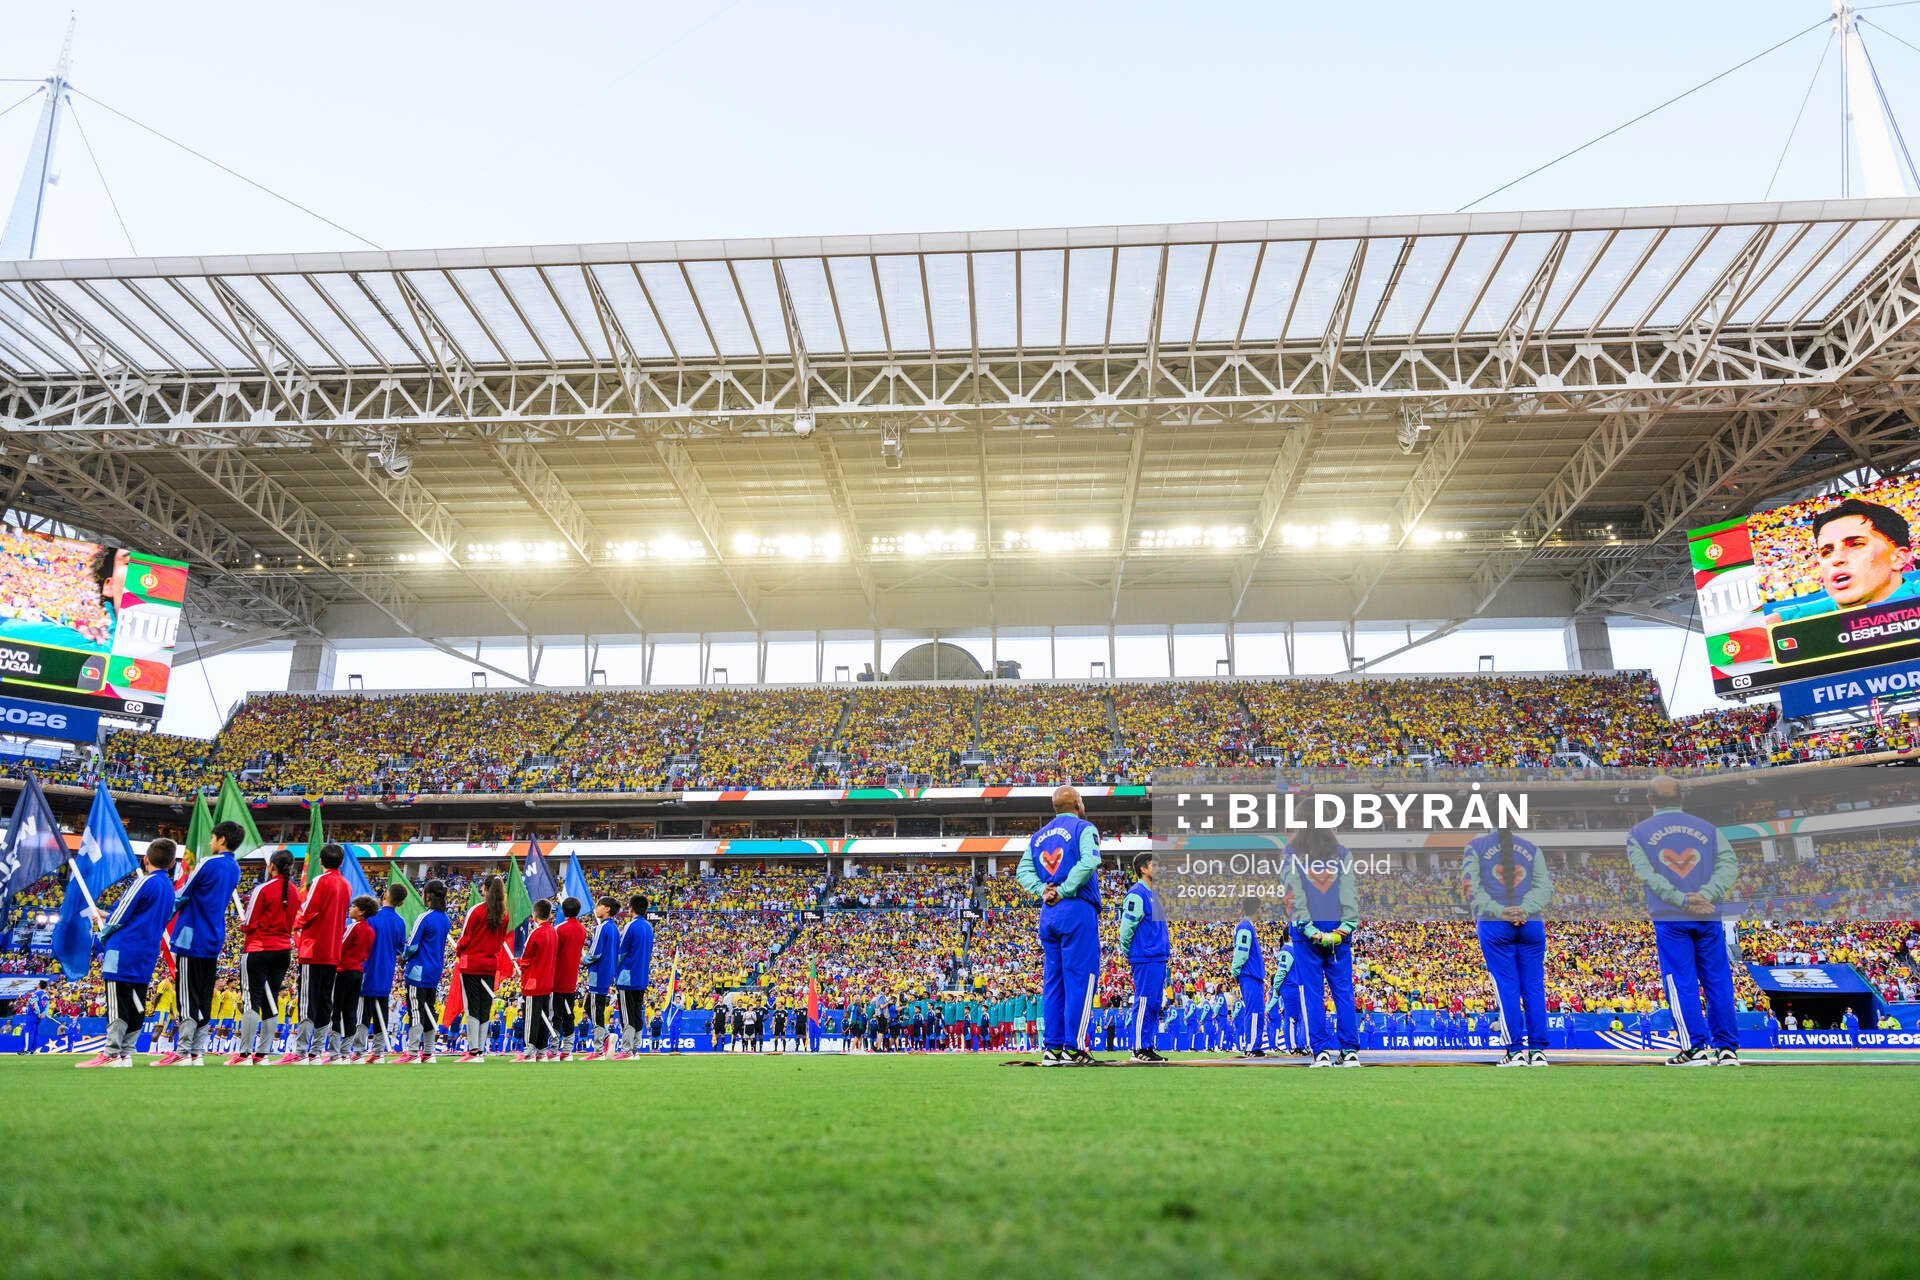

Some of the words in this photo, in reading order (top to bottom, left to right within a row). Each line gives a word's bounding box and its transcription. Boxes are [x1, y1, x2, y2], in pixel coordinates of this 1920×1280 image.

[1838, 632, 1850, 643] O
[1851, 618, 1920, 641] ESPLEND
[1734, 677, 1750, 687] CC
[1812, 681, 1865, 704] FIFA
[1865, 670, 1920, 694] WOR
[126, 702, 142, 712] CC
[1034, 827, 1072, 848] VOLUNTEER
[1647, 825, 1709, 846] VOLUNTEER
[1483, 843, 1533, 862] VOLTEER
[1778, 1034, 1806, 1045] FIFA
[1857, 1033, 1885, 1045] CUP
[1886, 1033, 1920, 1045] 202
